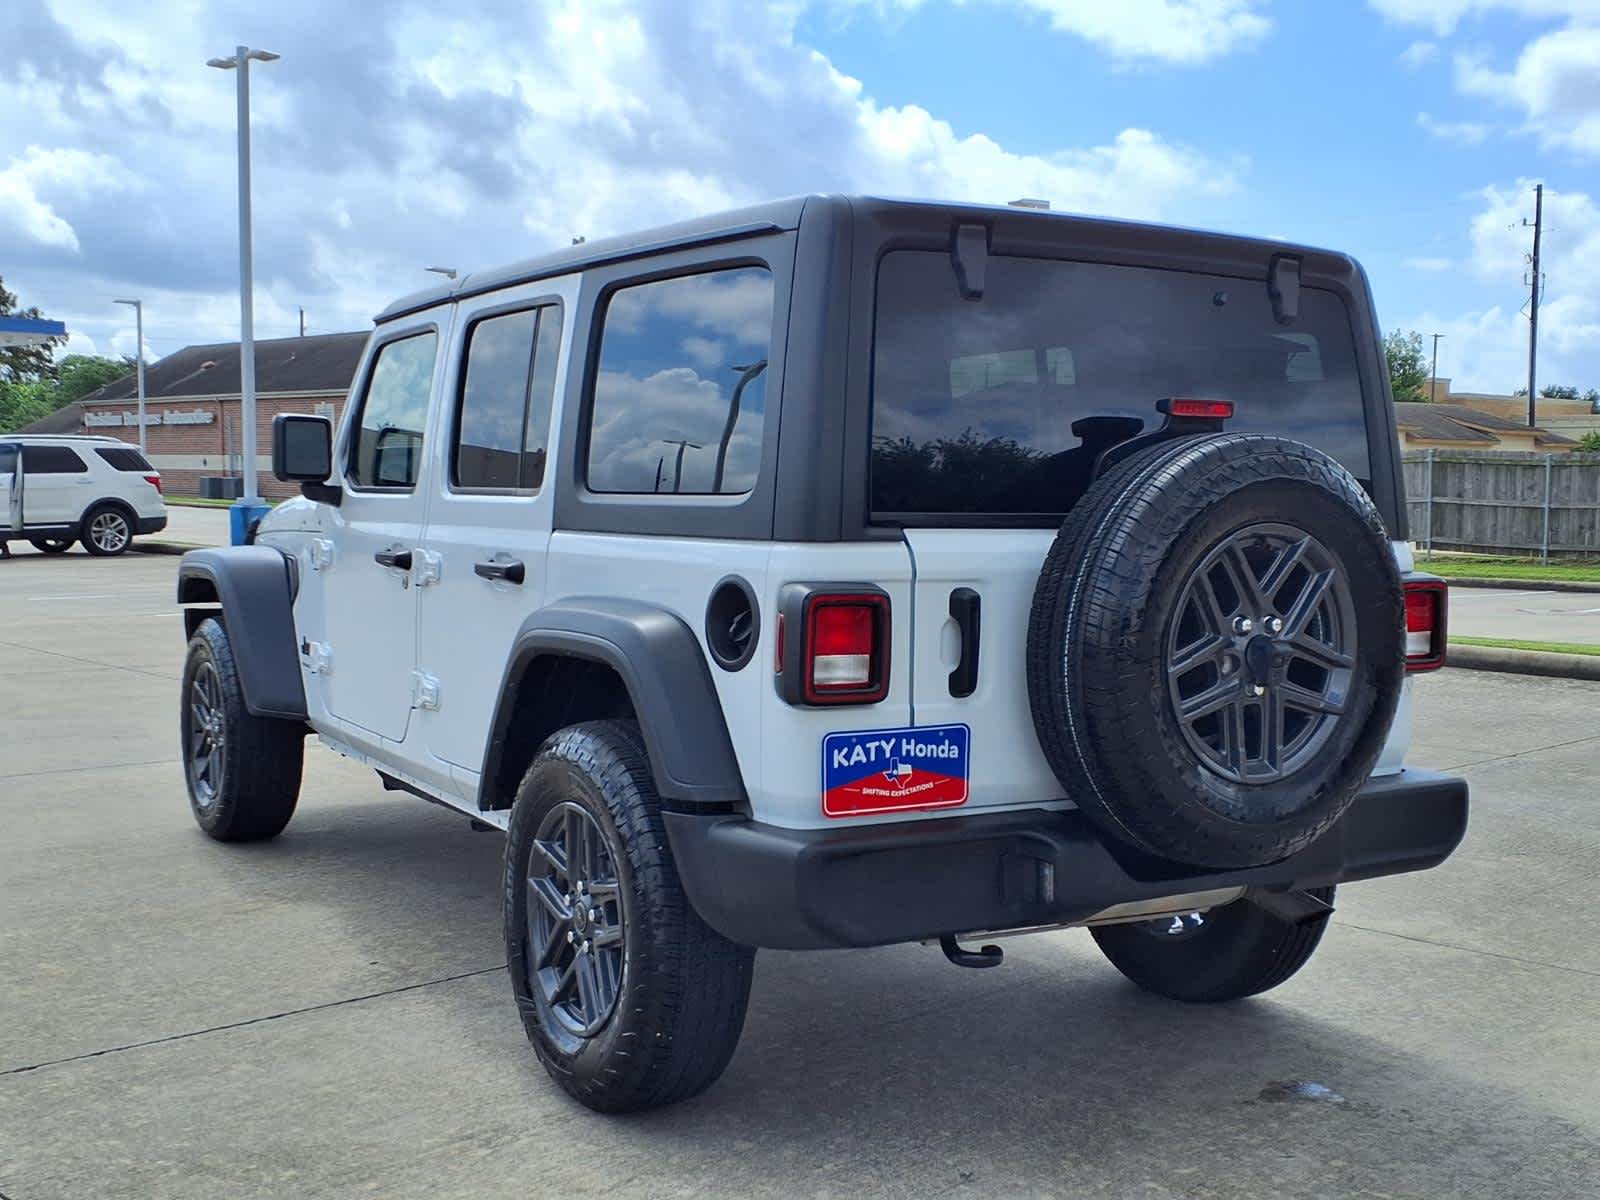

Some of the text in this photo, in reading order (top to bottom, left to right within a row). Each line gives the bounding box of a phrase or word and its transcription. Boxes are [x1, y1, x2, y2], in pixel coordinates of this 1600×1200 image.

[834, 738, 959, 768] KATY Honda
[862, 782, 934, 797] SHIFTING EXPECTATIONS
